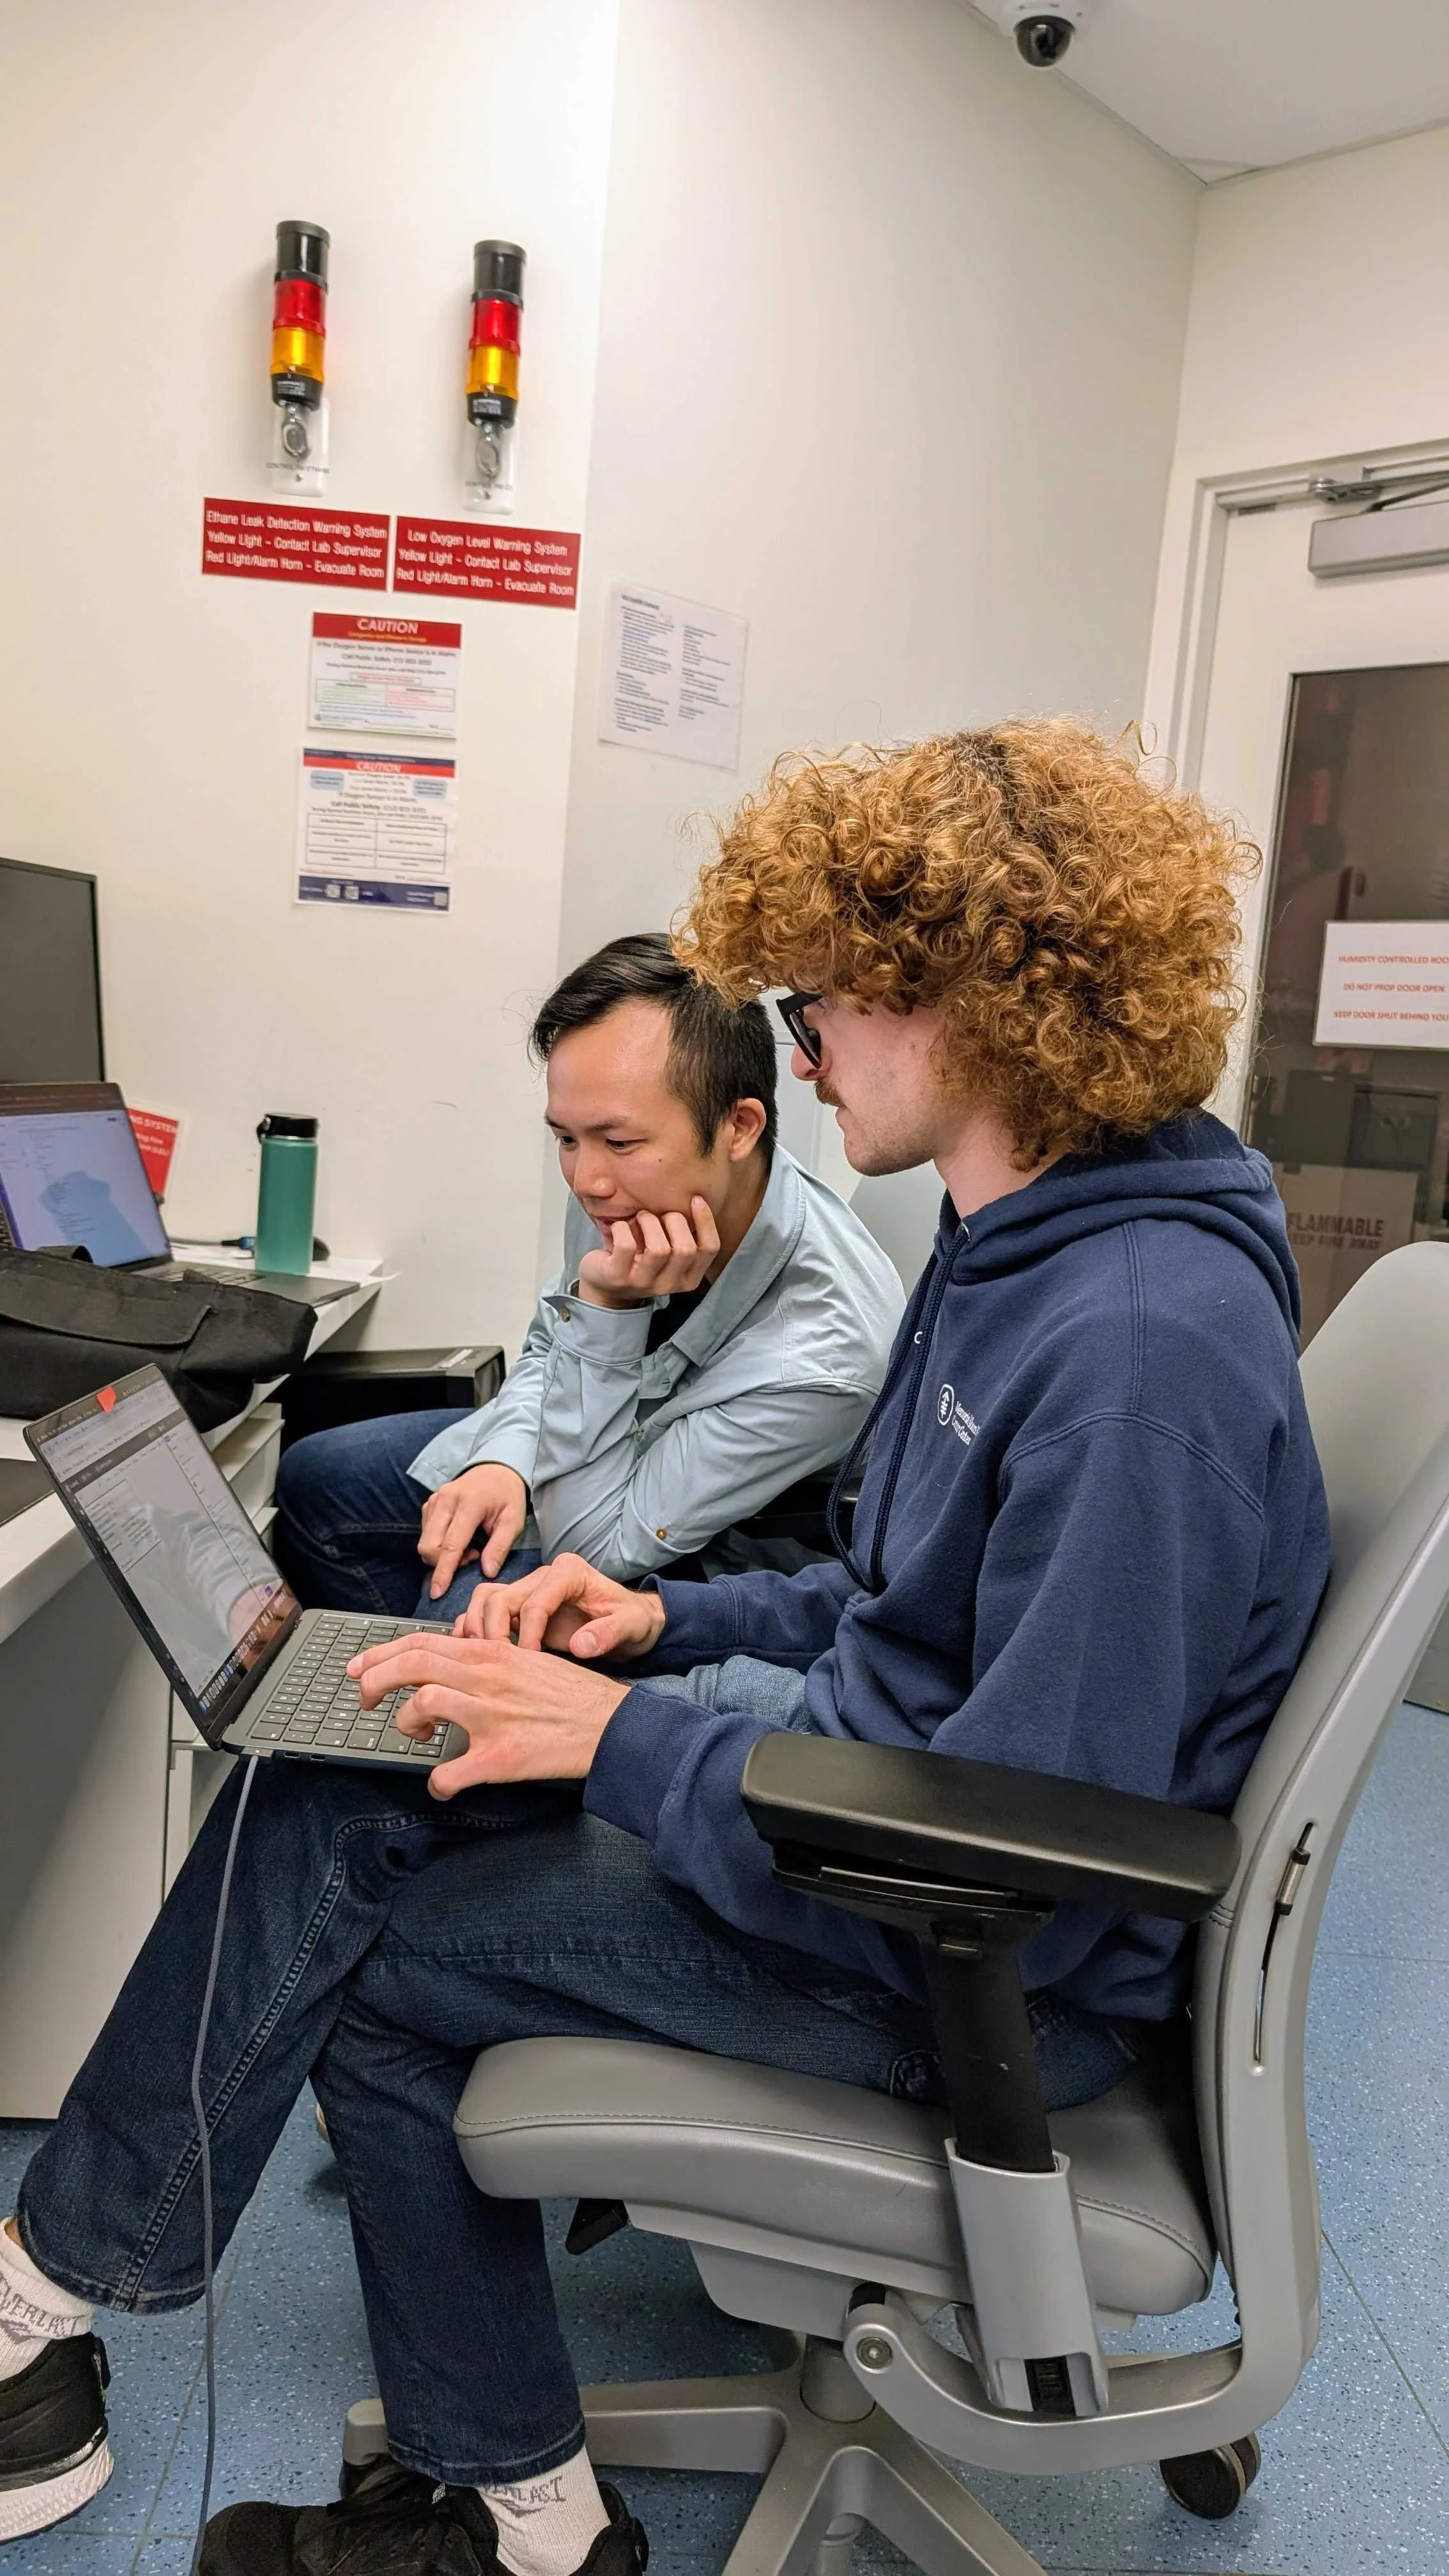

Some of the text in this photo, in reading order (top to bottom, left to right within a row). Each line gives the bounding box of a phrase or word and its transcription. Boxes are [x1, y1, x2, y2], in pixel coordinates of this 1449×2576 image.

[206, 509, 387, 539] Ethane Leak Detection Warning System
[207, 530, 236, 544] Yellow
[238, 534, 262, 548] Light
[273, 537, 310, 551] Contact
[312, 540, 330, 553] Lab
[333, 542, 382, 558] Supervisor
[408, 529, 567, 556] Low Oxygen Level Warning System
[205, 550, 224, 563] Red
[226, 552, 278, 568] Light/Alarm
[280, 558, 303, 571] Horn
[314, 560, 356, 576] Evacuate
[358, 564, 384, 578] Room
[398, 548, 427, 562] Yellow
[429, 551, 452, 566] Light
[464, 555, 500, 570] Contact
[502, 558, 521, 571] Lab
[523, 560, 573, 576] Supervisor
[396, 567, 414, 581] Red
[417, 570, 468, 586] Light/Alarm
[471, 575, 493, 588] Horn
[504, 578, 546, 594] Evacuate
[549, 582, 574, 596] Room
[356, 618, 418, 634] CAUTION
[356, 760, 402, 773] CAUTION
[1377, 956, 1429, 964] CONTROLLED
[1334, 1010, 1352, 1018] KEEP
[1287, 1213, 1384, 1237] FLAMMABLE
[0, 2273, 86, 2338] VERLAST
